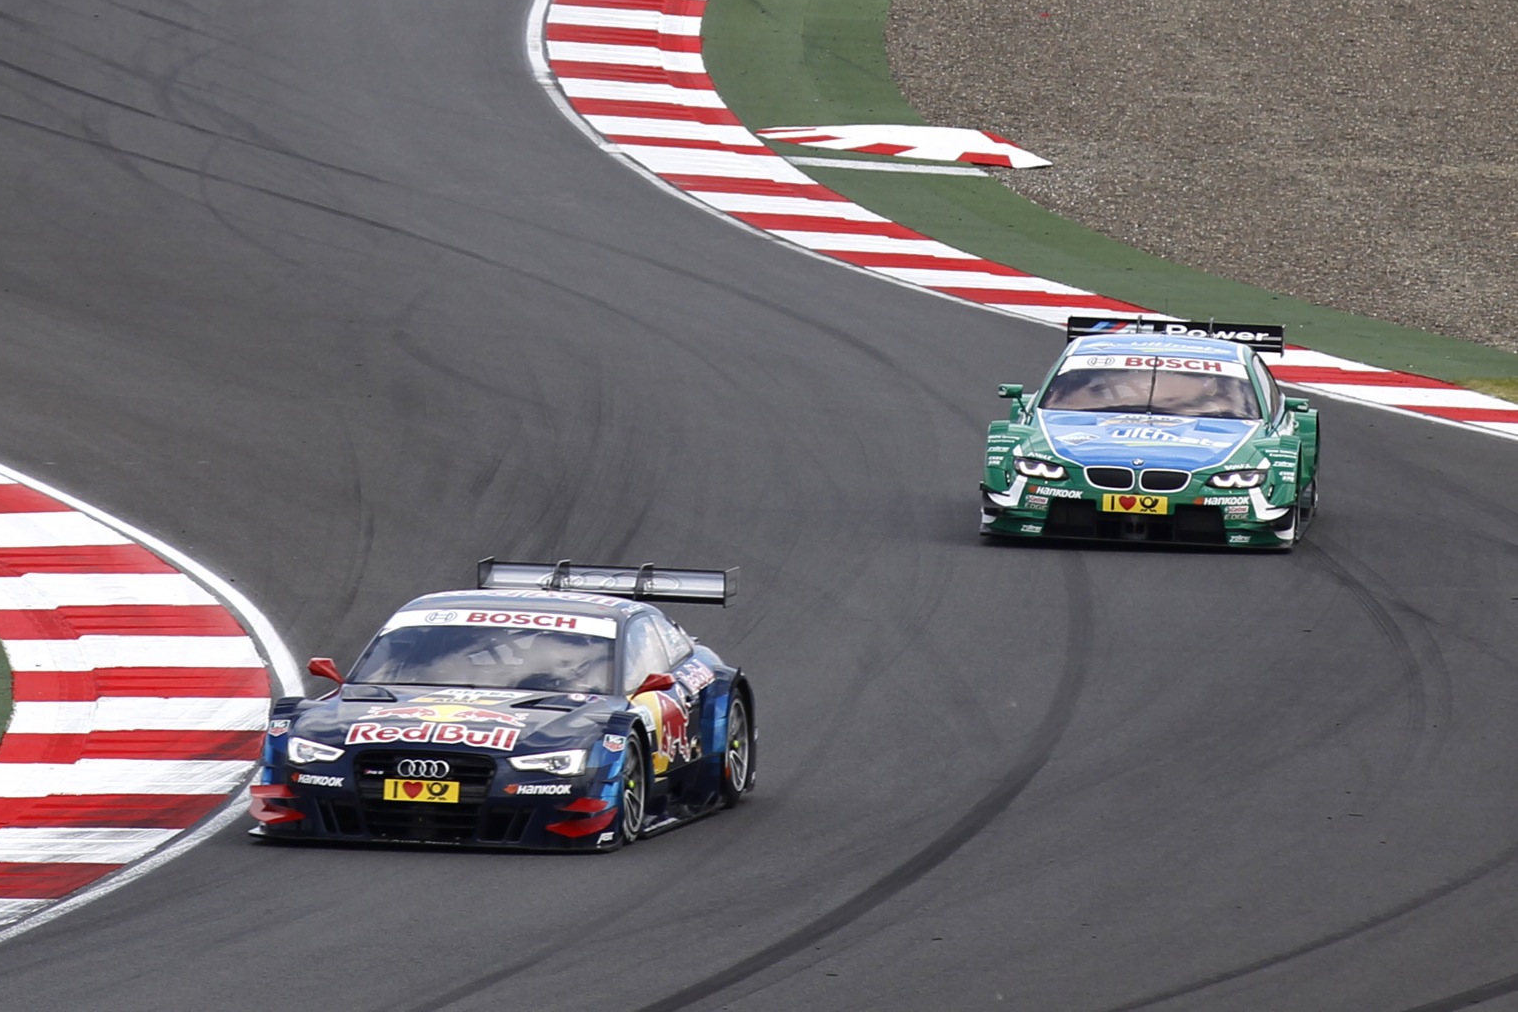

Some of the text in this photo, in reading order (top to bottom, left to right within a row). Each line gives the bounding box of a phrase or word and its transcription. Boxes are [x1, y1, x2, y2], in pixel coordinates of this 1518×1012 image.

[1165, 324, 1269, 342] Power
[1124, 356, 1223, 372] BOSCH
[1111, 427, 1234, 448] ultimate
[466, 612, 577, 629] BOSCH
[347, 723, 519, 750] Red Bull
